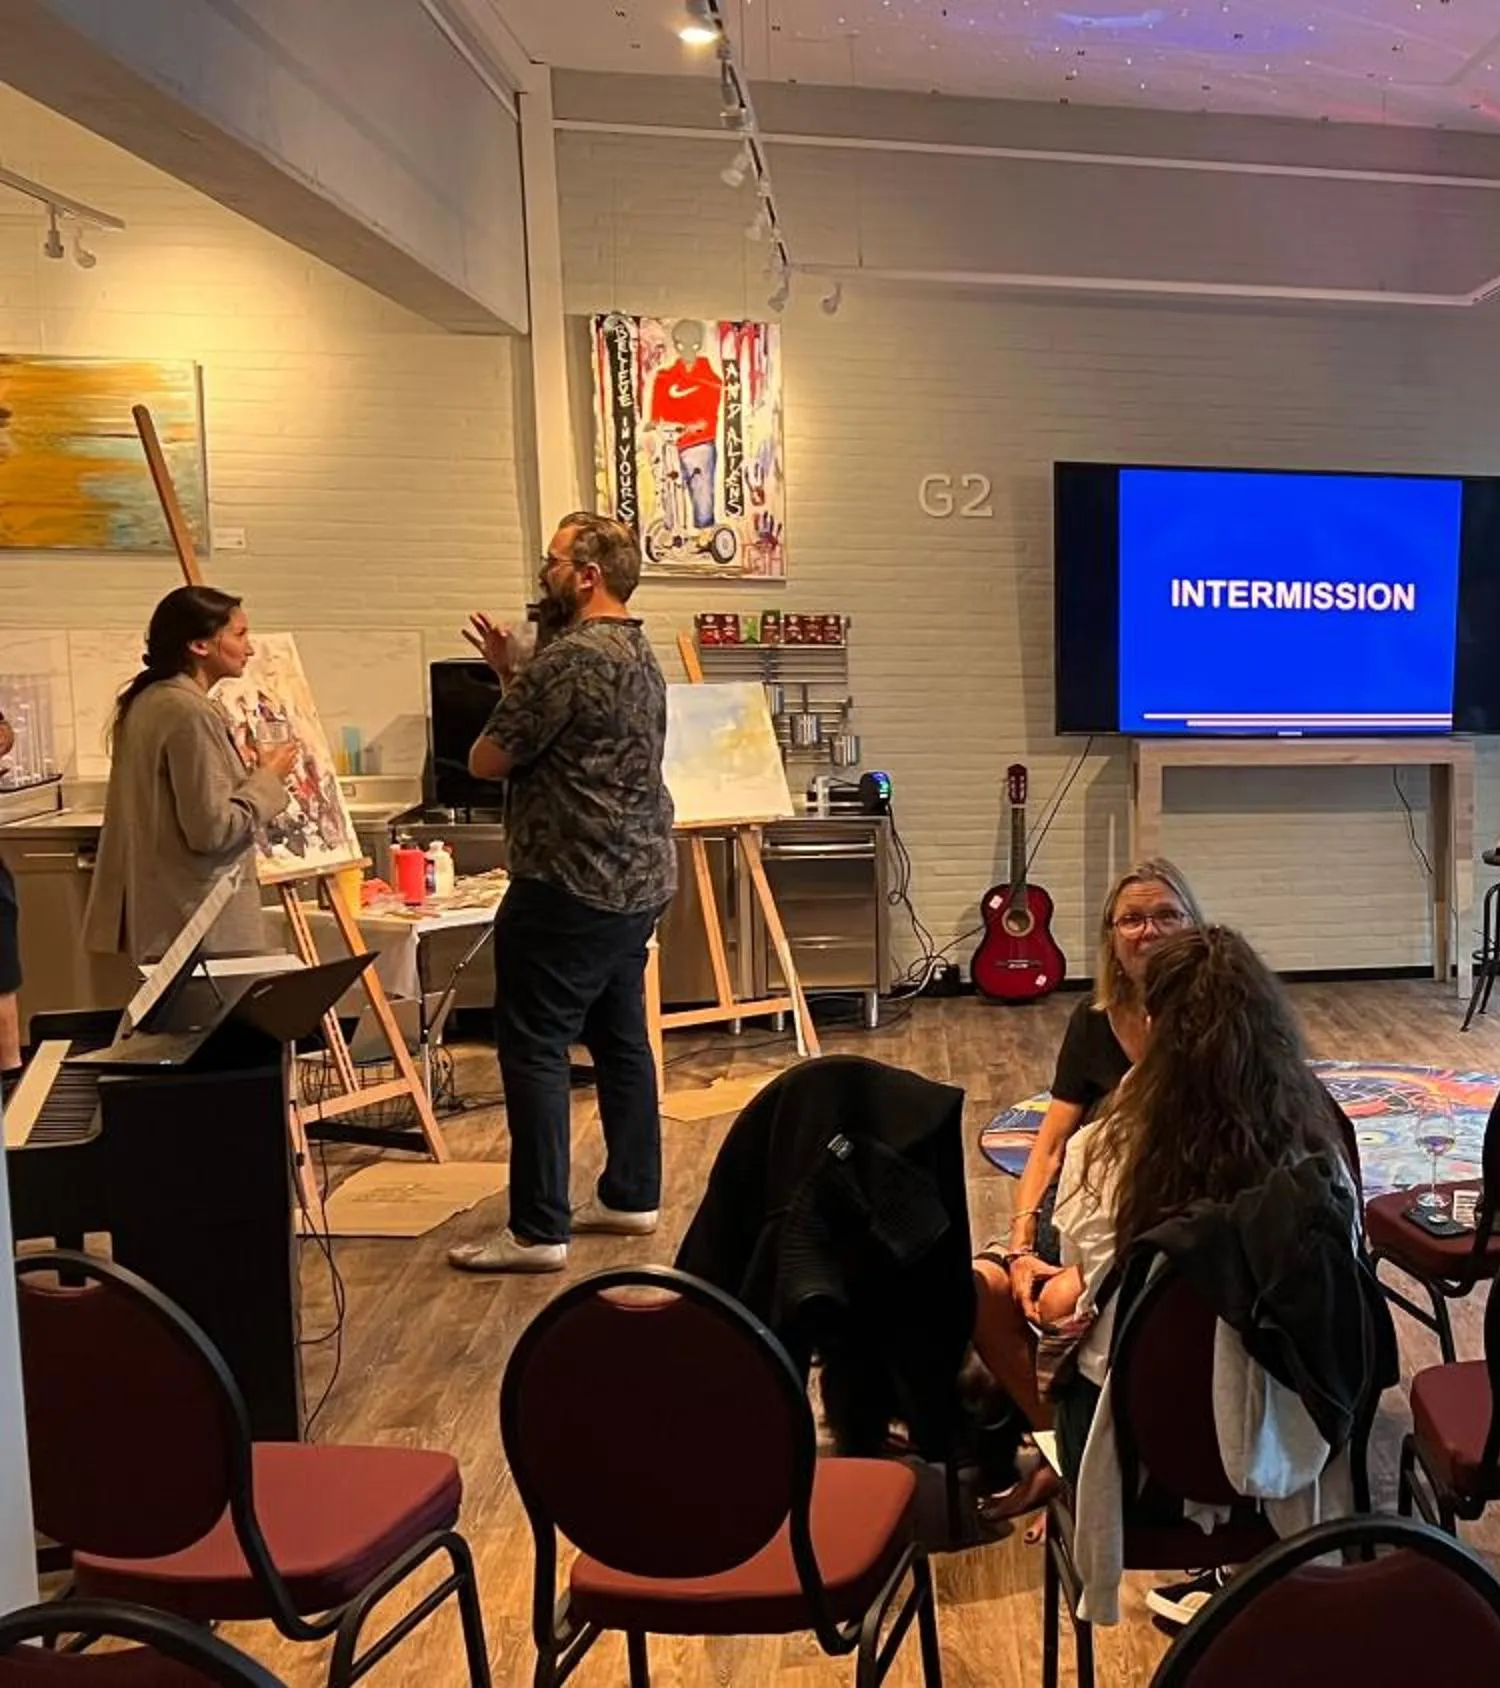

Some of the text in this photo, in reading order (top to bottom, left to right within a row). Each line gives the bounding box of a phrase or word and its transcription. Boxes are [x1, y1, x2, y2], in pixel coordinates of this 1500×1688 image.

[620, 415, 632, 440] IN
[617, 443, 636, 528] YOURS
[918, 473, 994, 518] G2
[1170, 579, 1416, 611] INTERMISSION
